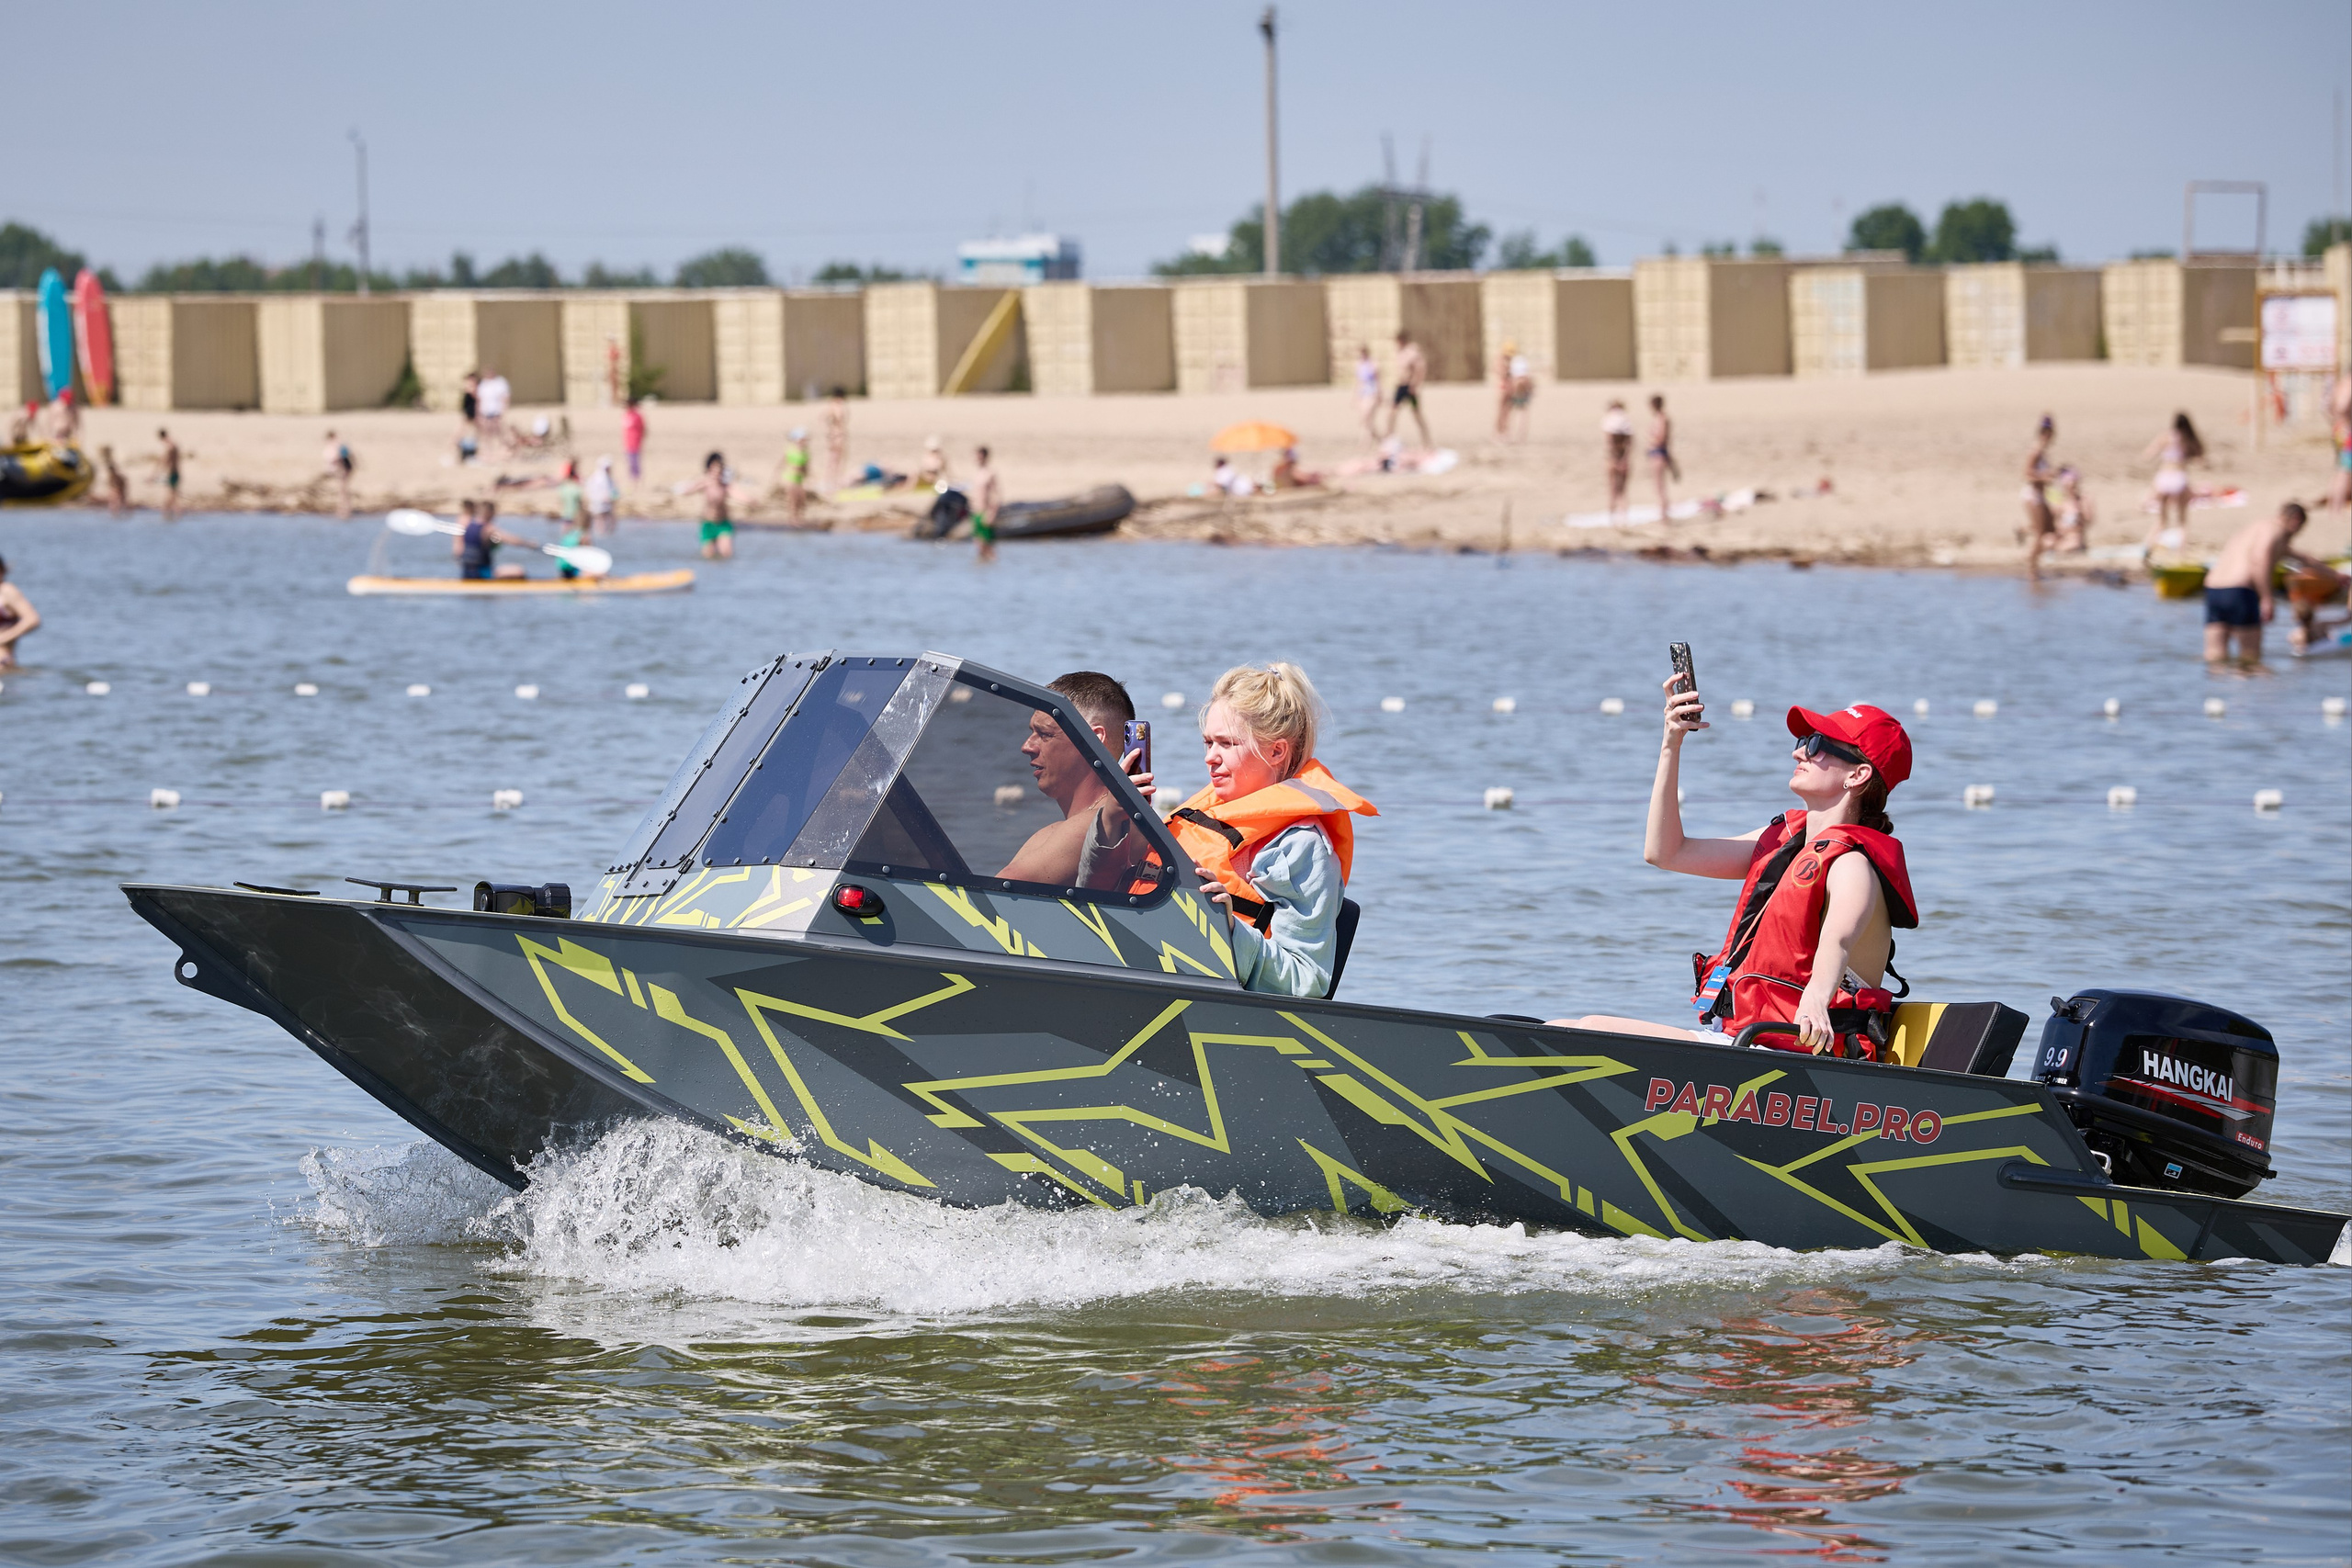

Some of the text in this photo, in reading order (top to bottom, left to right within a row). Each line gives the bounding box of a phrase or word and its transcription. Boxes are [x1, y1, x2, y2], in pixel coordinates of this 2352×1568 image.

[1795, 857, 1818, 880] B
[2043, 1046, 2068, 1068] 9.9
[2143, 1050, 2233, 1102] HANGKAI
[1644, 1077, 1943, 1145] PARABEL.PRO
[2237, 1133, 2262, 1150] Enduro
